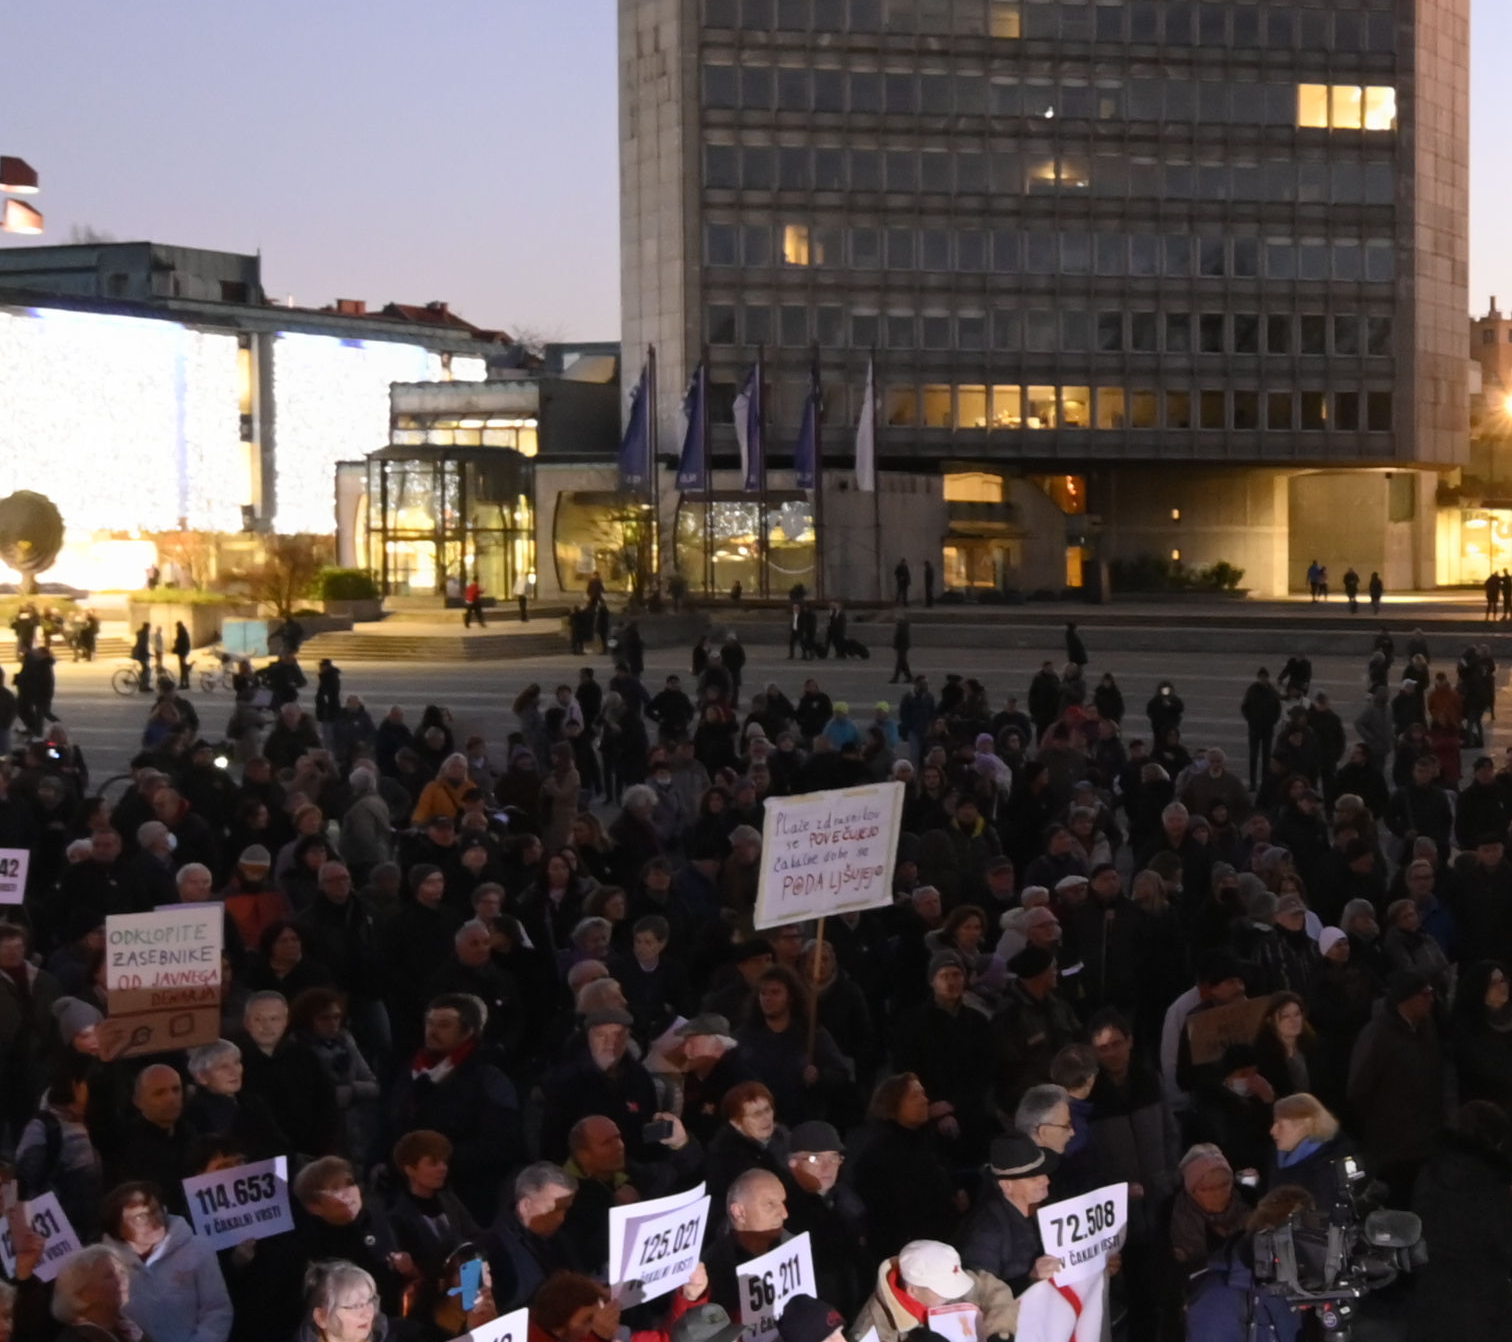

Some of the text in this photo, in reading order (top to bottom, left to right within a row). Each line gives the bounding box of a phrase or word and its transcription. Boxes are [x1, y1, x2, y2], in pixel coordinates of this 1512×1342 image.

[110, 924, 207, 945] ODKLOPITE
[113, 946, 215, 968] ZASEBNIKE
[151, 969, 217, 987] JAVNEGA
[196, 1173, 276, 1215] 114.653
[214, 1213, 252, 1234] ČAKALNI
[255, 1205, 281, 1222] VRSTI
[1050, 1200, 1115, 1247] 72.508
[639, 1216, 701, 1266] 125.021
[748, 1254, 801, 1311] 56.211
